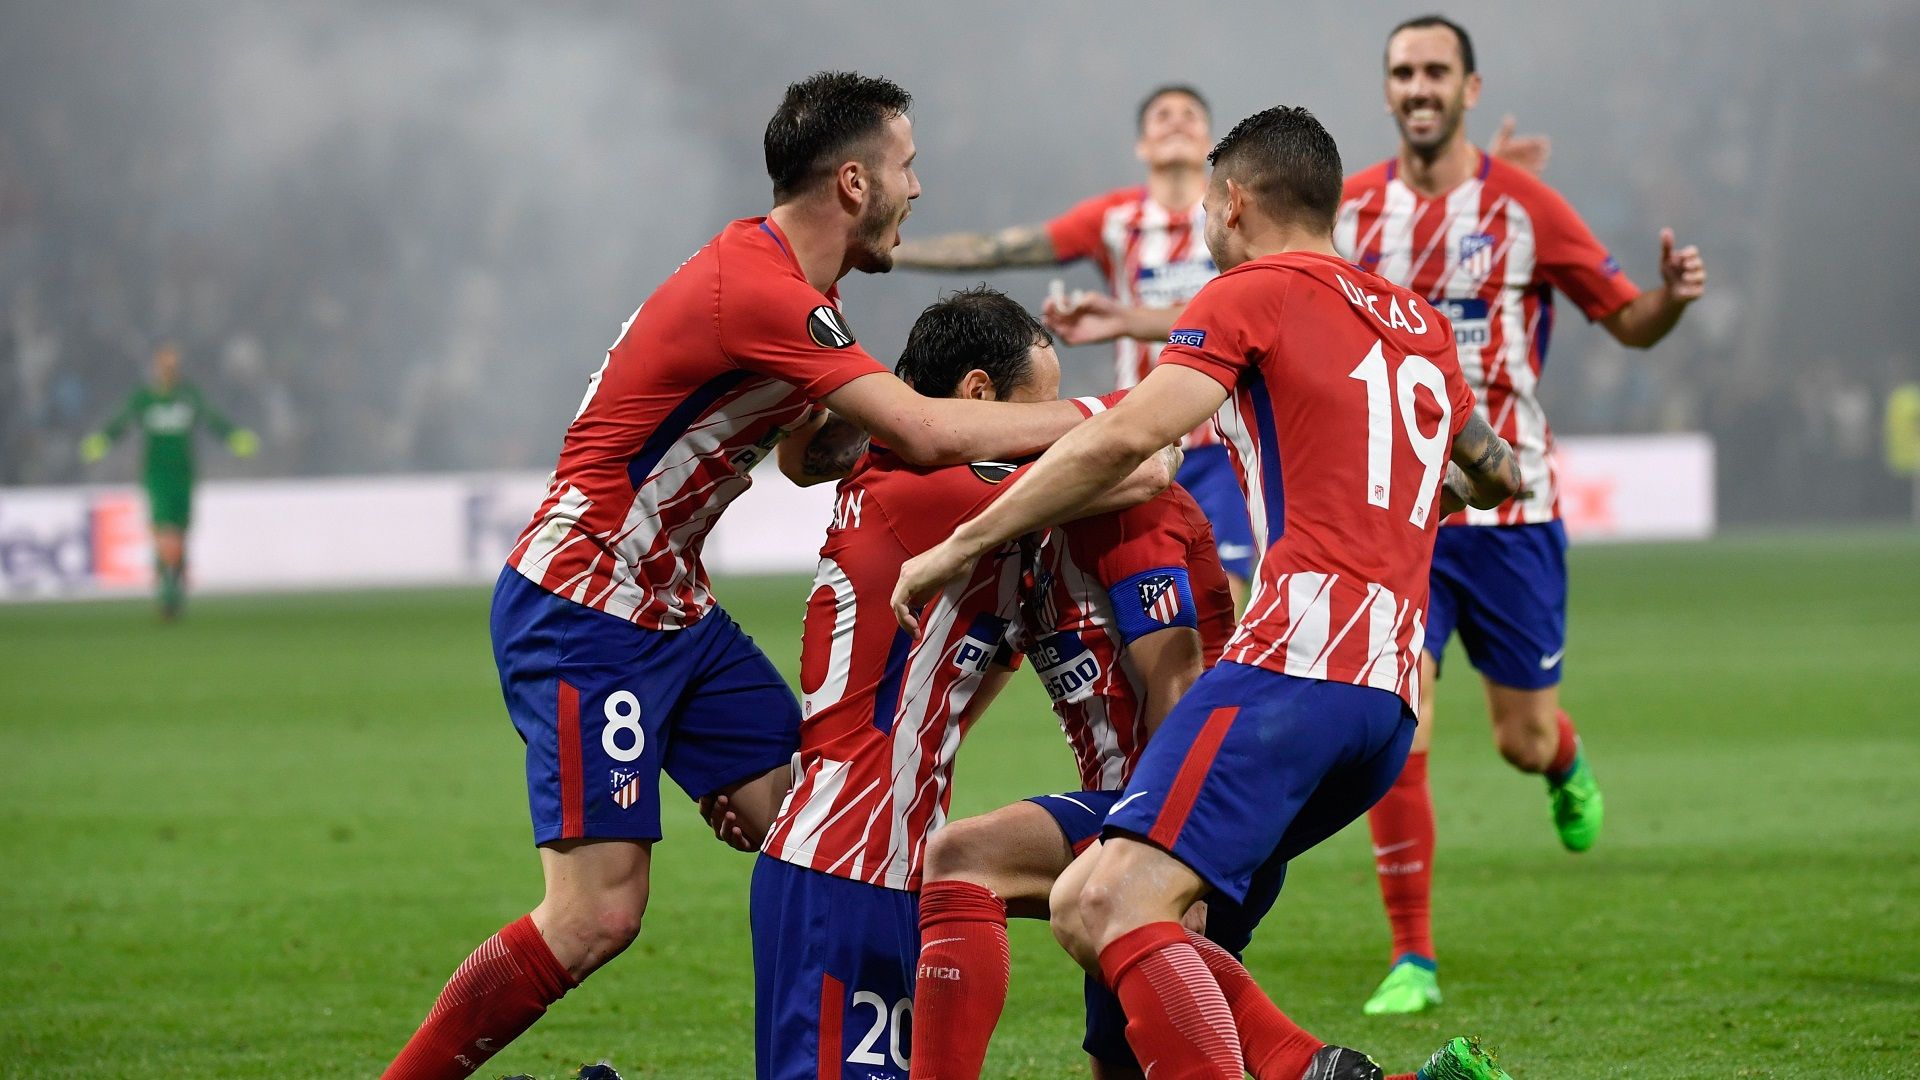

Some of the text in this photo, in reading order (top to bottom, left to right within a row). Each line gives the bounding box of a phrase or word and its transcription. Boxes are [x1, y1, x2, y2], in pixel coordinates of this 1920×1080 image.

[1348, 338, 1452, 531] 19
[601, 690, 645, 762] 8
[916, 963, 961, 981] ÉTICO
[846, 990, 914, 1071] 20
